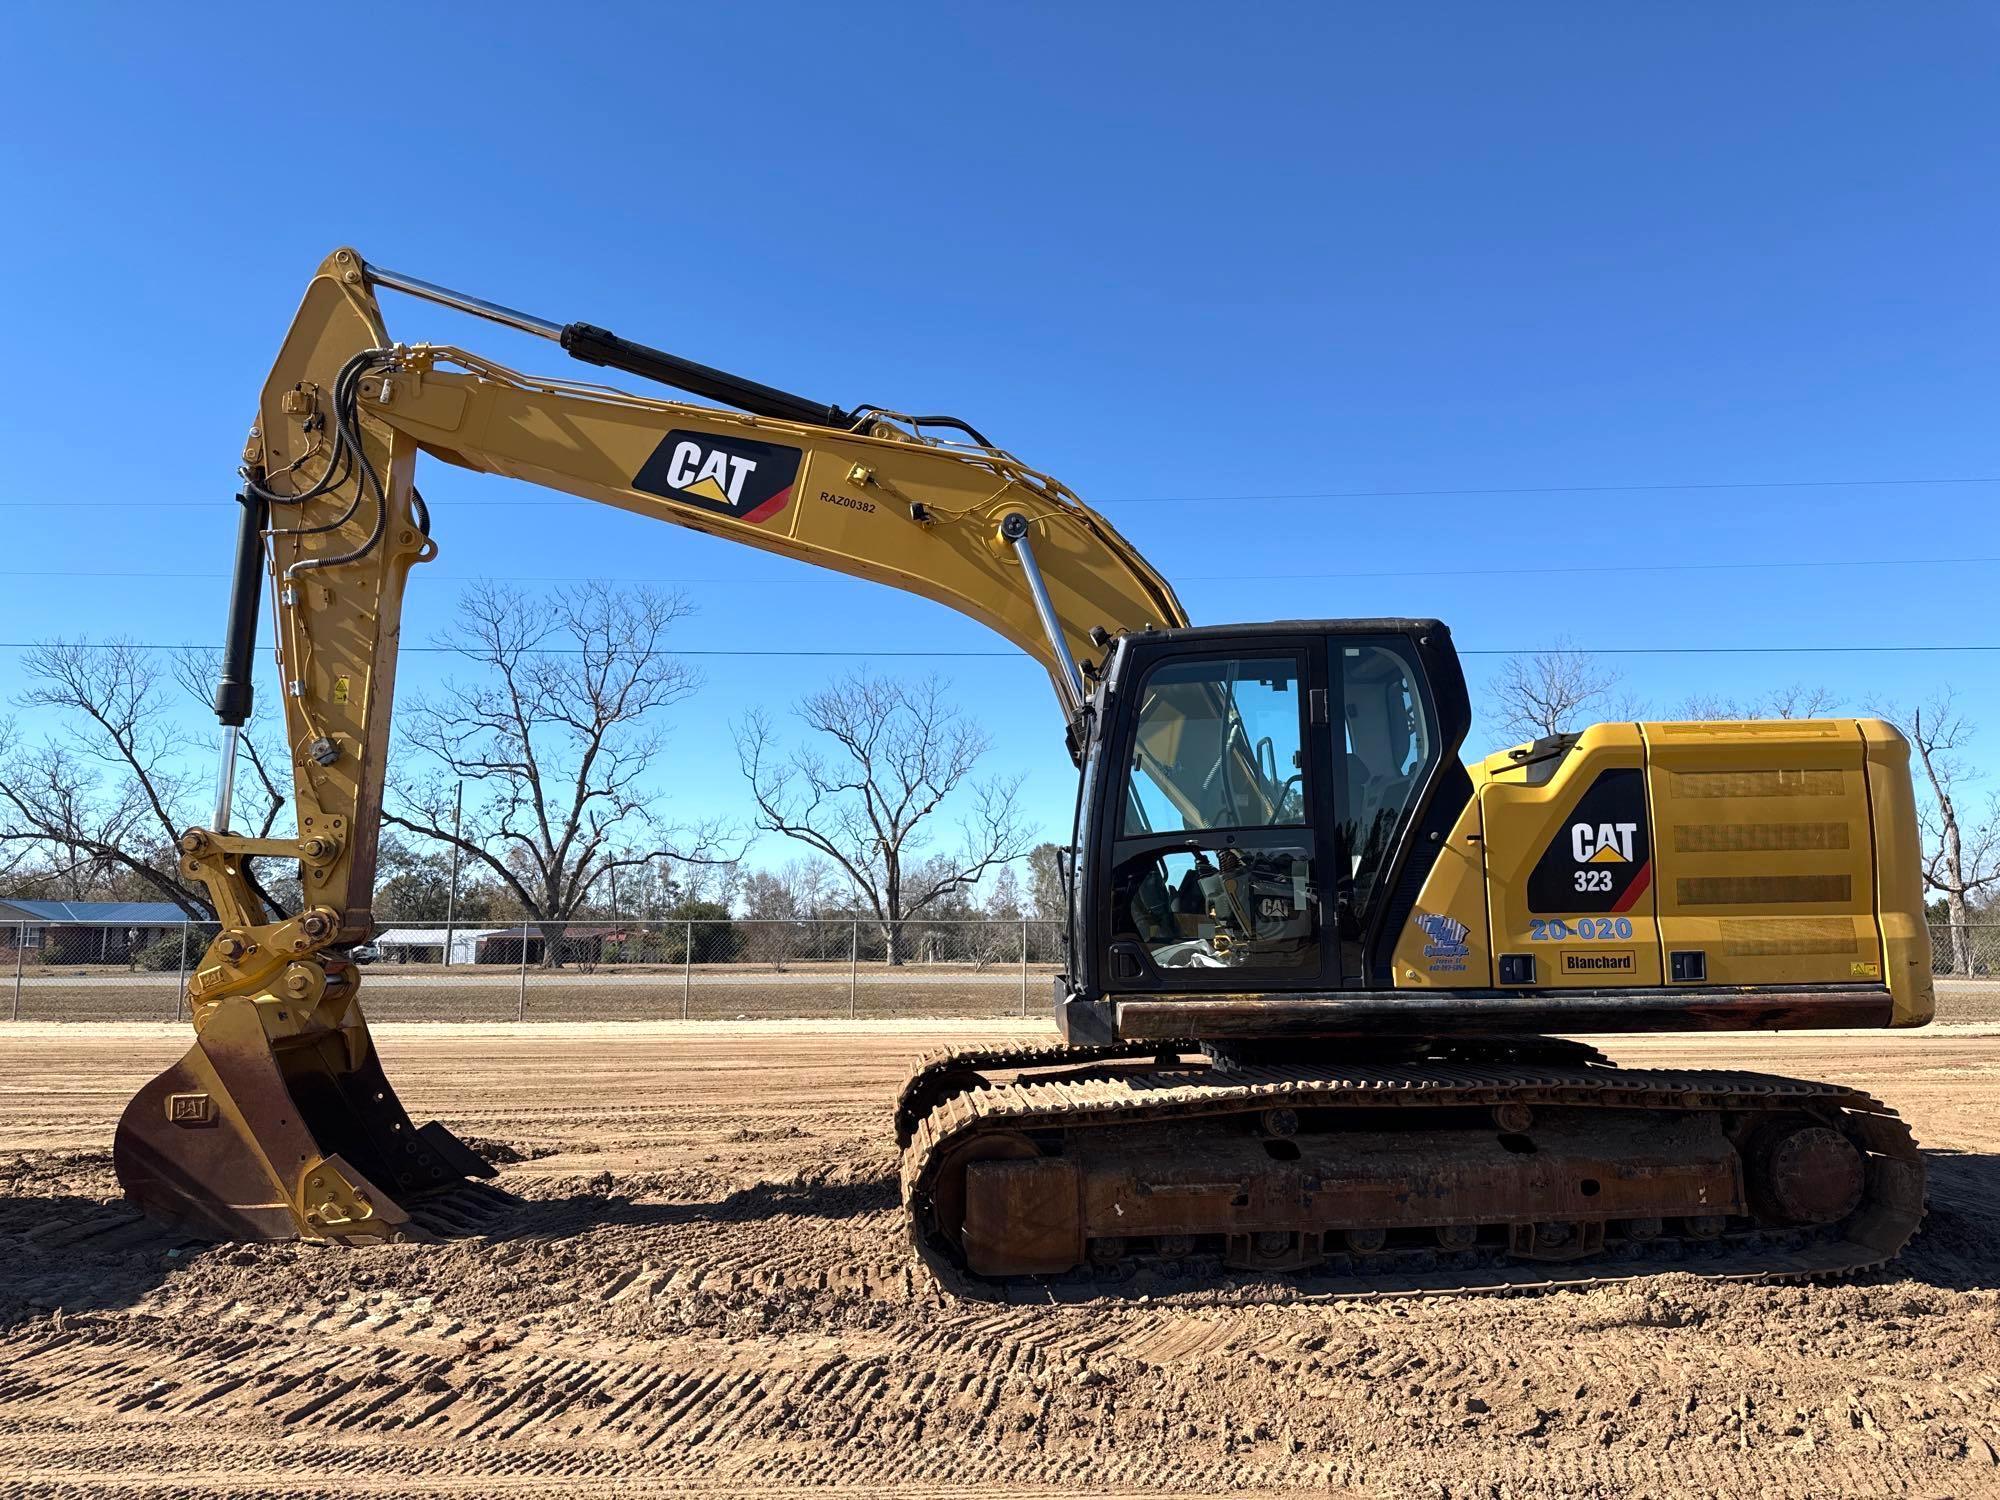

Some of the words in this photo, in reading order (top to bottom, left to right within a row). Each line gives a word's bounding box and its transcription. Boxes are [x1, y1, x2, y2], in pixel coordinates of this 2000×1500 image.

[666, 441, 757, 506] CAT
[820, 491, 876, 514] RAZ00382
[1571, 823, 1637, 863] CAT
[1574, 870, 1613, 892] 323
[1529, 917, 1633, 941] 20-020
[1567, 956, 1631, 969] Blanchard
[175, 1099, 206, 1119] CAT
